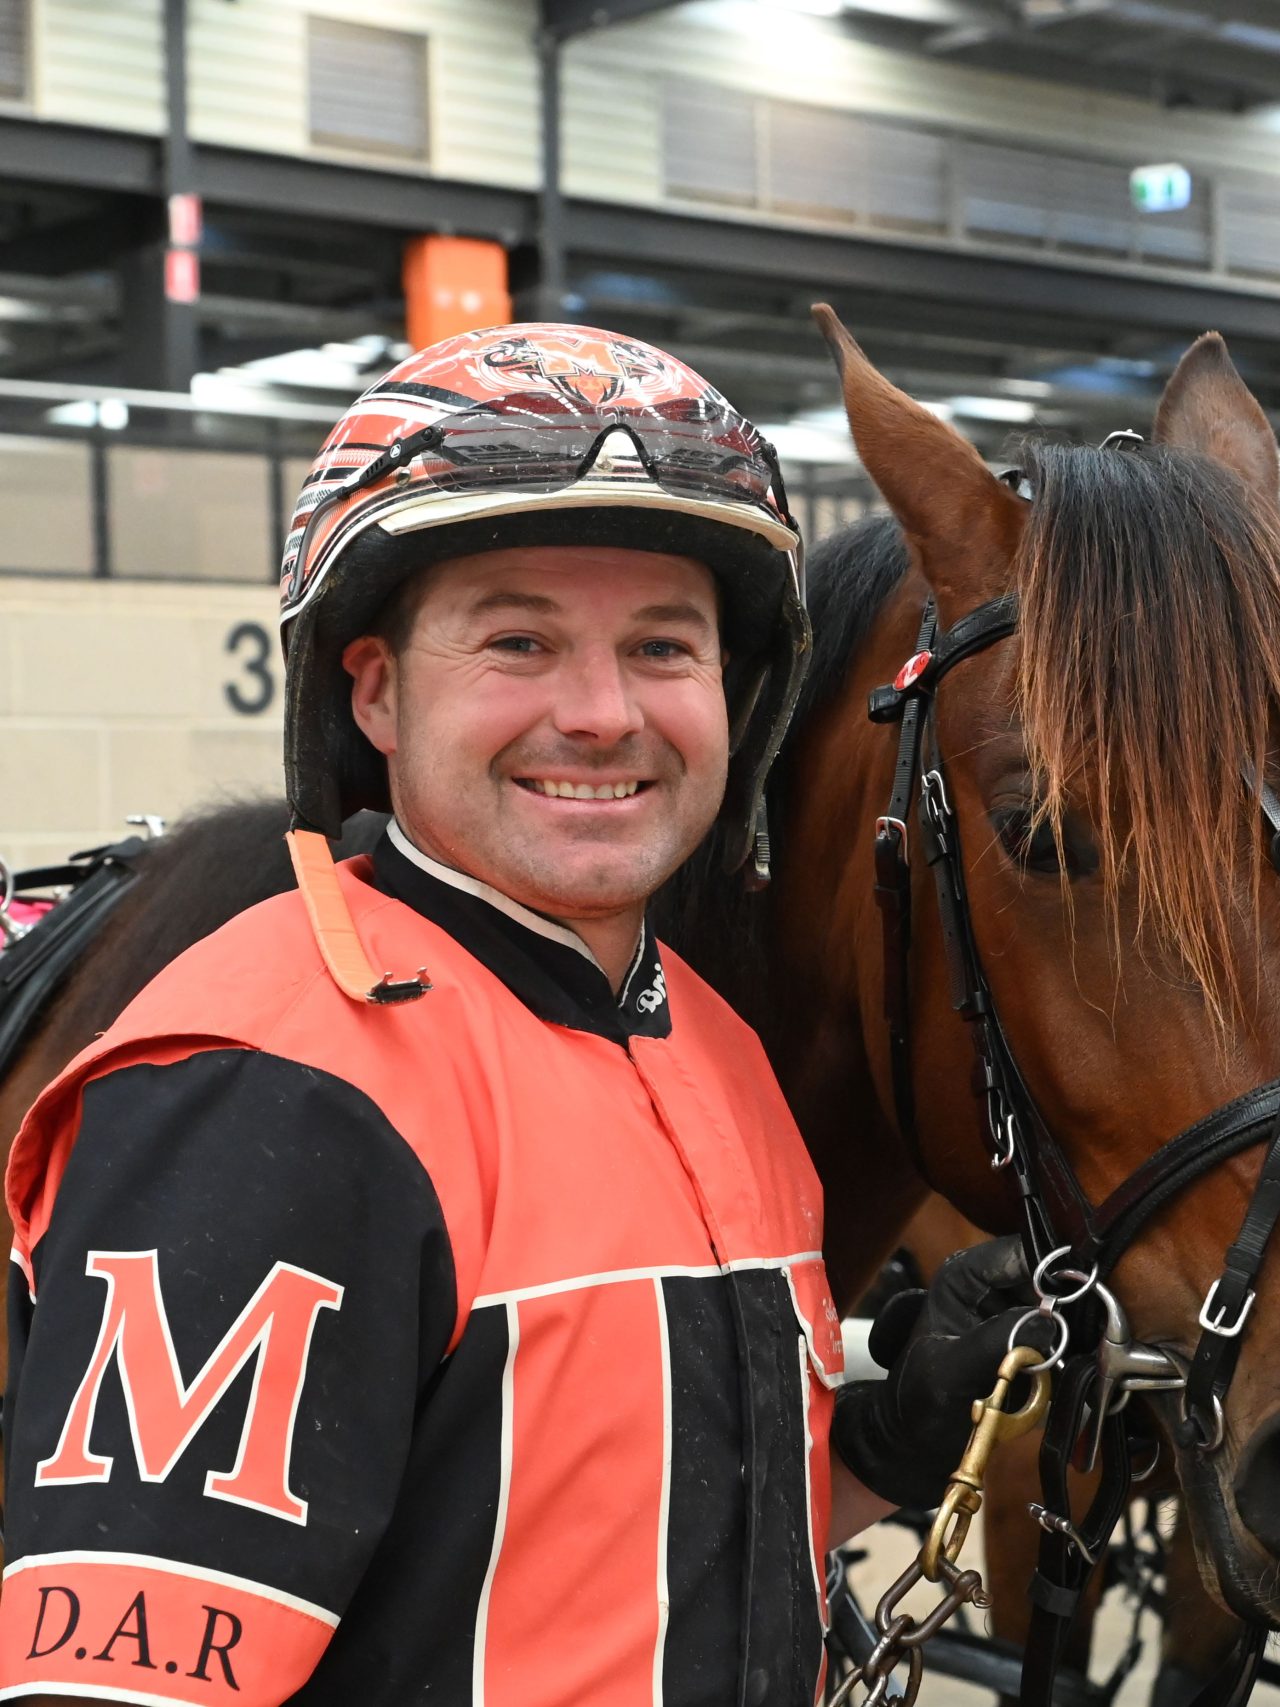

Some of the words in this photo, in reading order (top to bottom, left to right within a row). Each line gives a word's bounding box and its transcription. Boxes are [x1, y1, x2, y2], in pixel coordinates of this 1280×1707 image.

[529, 335, 630, 378] M
[34, 1248, 345, 1526] M
[25, 1585, 242, 1692] D.A.R
